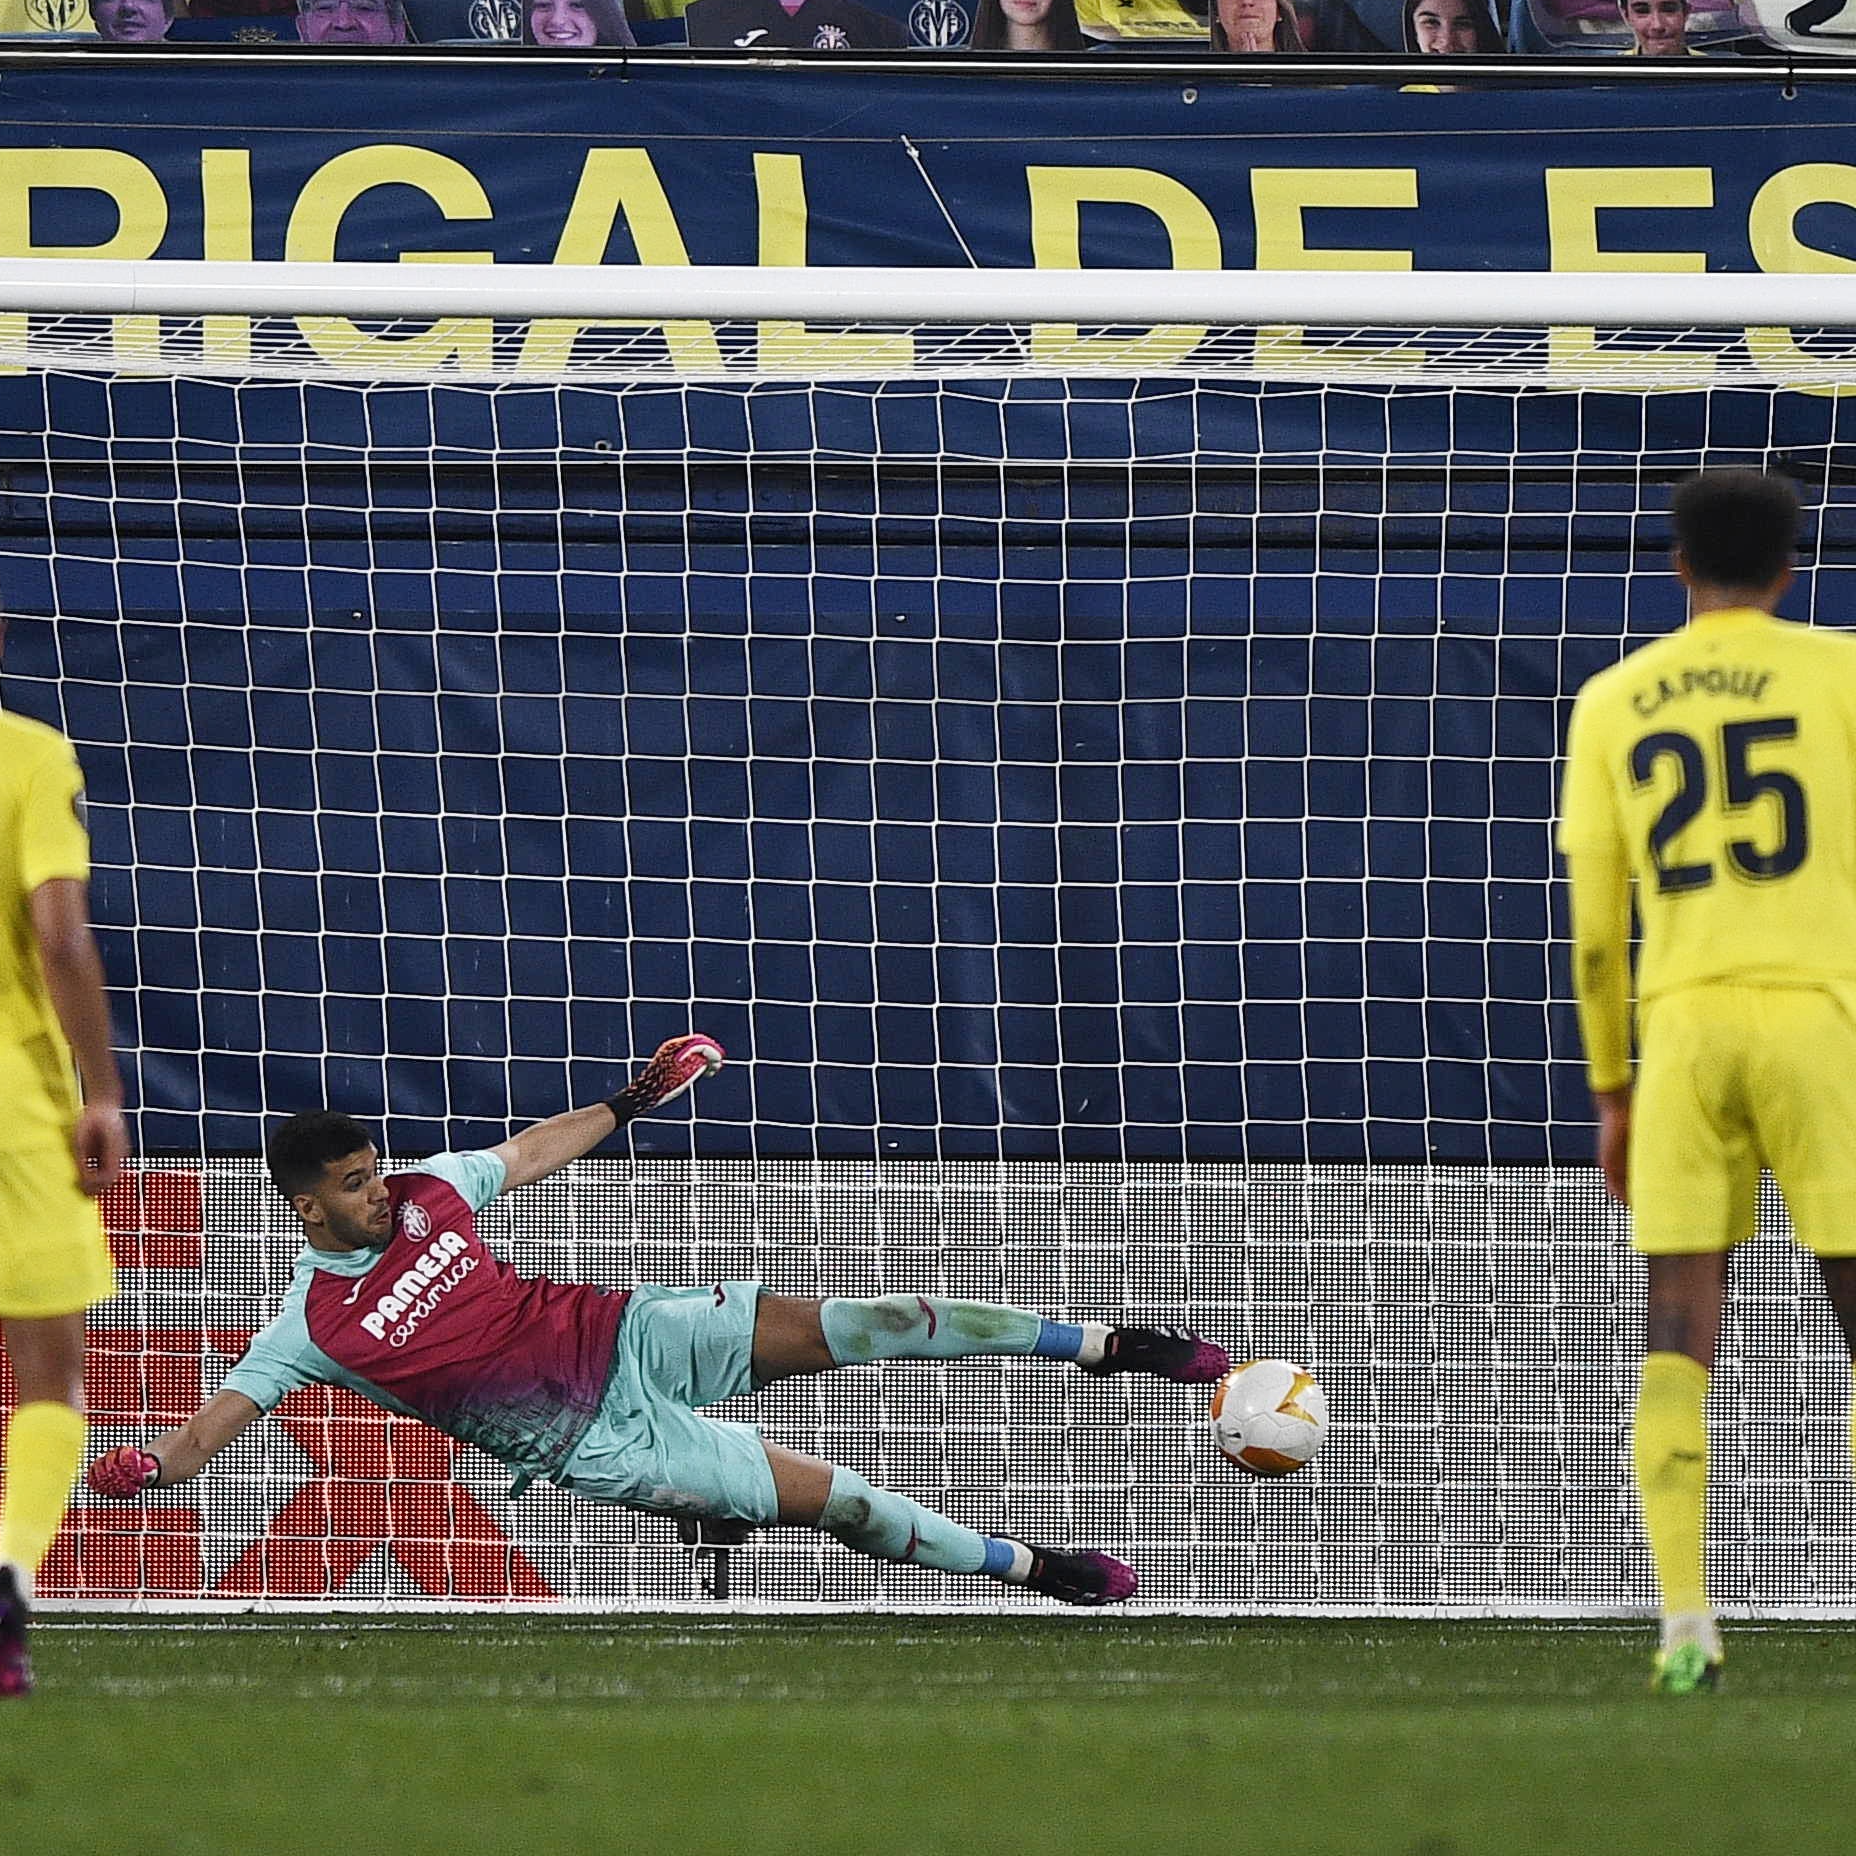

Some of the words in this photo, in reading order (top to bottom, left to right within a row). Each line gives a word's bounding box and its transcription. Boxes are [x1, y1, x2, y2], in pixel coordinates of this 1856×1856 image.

[1024, 164, 1426, 377] DE
[1628, 715, 1809, 895] 25
[360, 1231, 470, 1341] PAMESA
